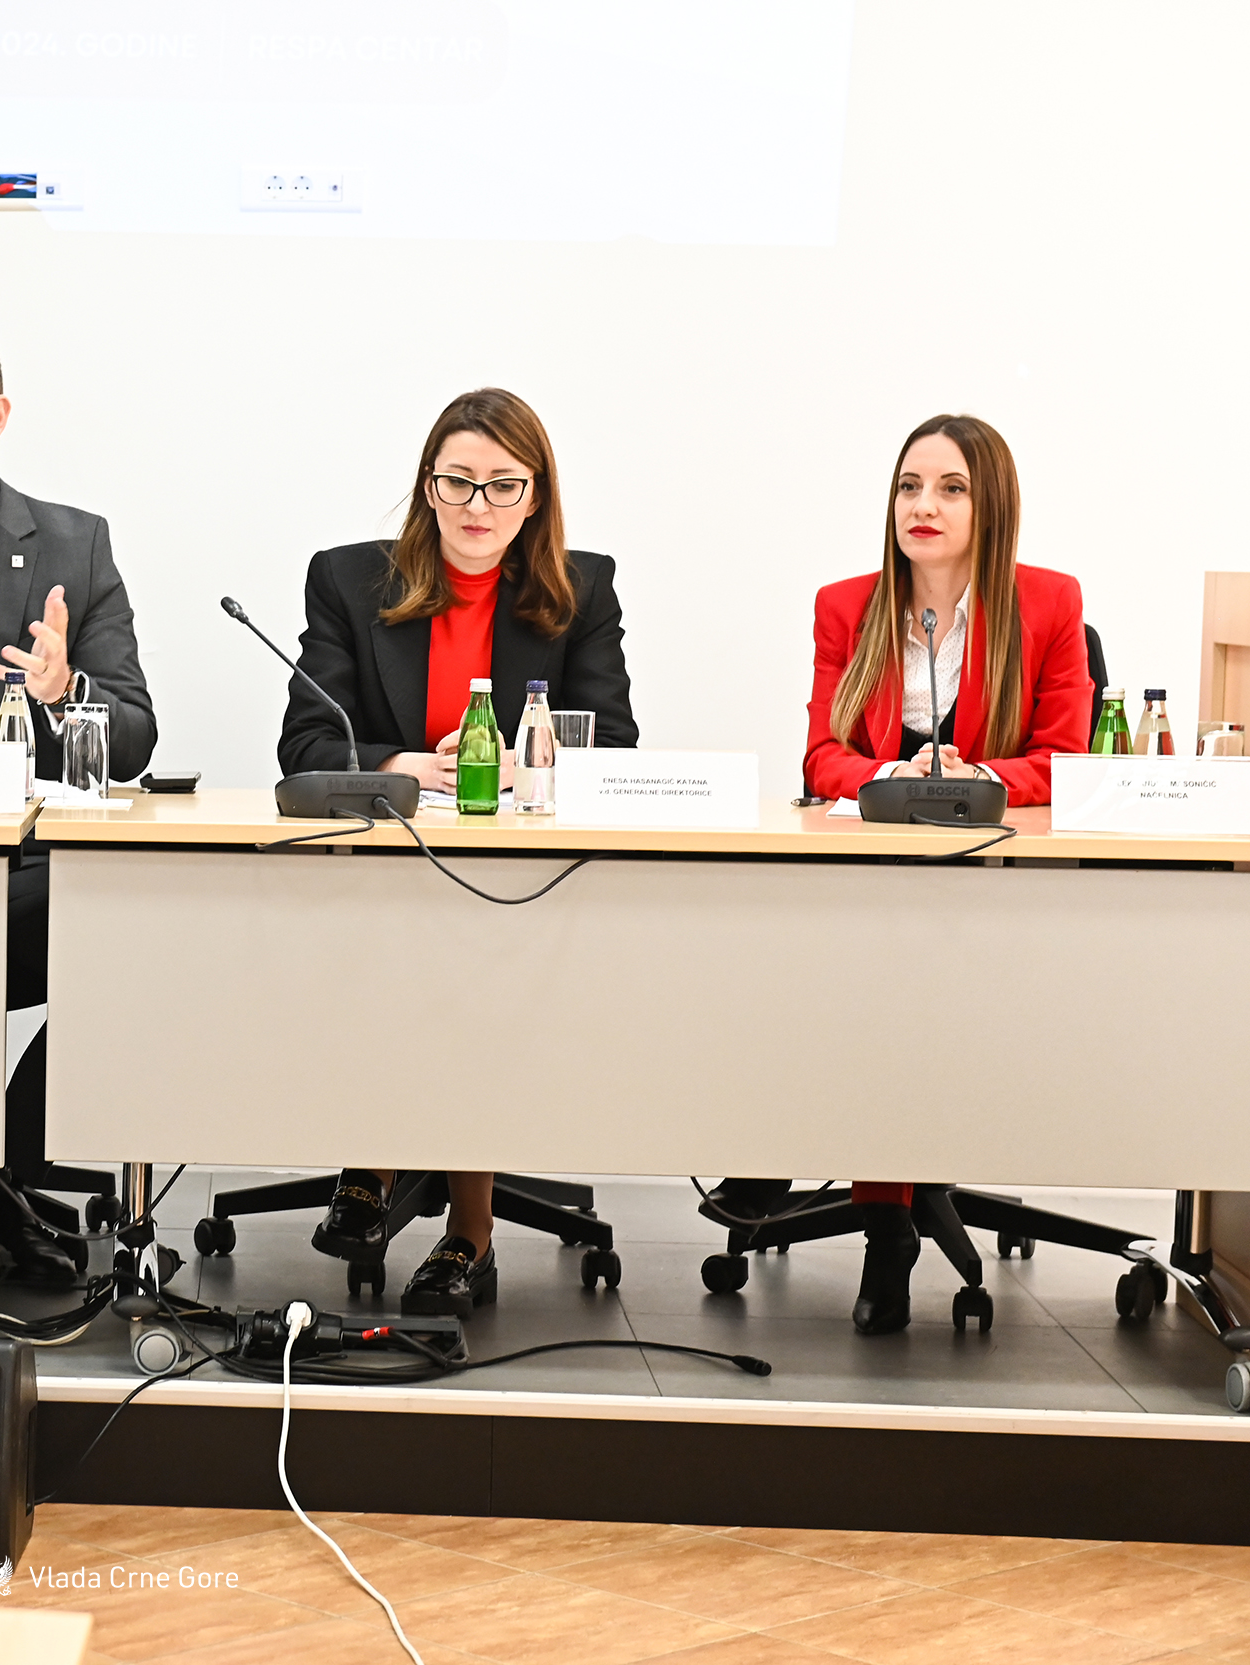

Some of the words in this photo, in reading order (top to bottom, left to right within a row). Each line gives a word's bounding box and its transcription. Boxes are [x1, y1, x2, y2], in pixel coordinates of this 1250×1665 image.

[74, 32, 197, 59] GODINE
[248, 34, 347, 61] RESPA
[354, 35, 486, 63] CENTAR
[346, 780, 388, 790] BOSCH
[602, 777, 628, 785] ENESA
[676, 779, 708, 787] KATANA
[613, 788, 659, 796] GENERALNE
[927, 786, 971, 797] BOSCH
